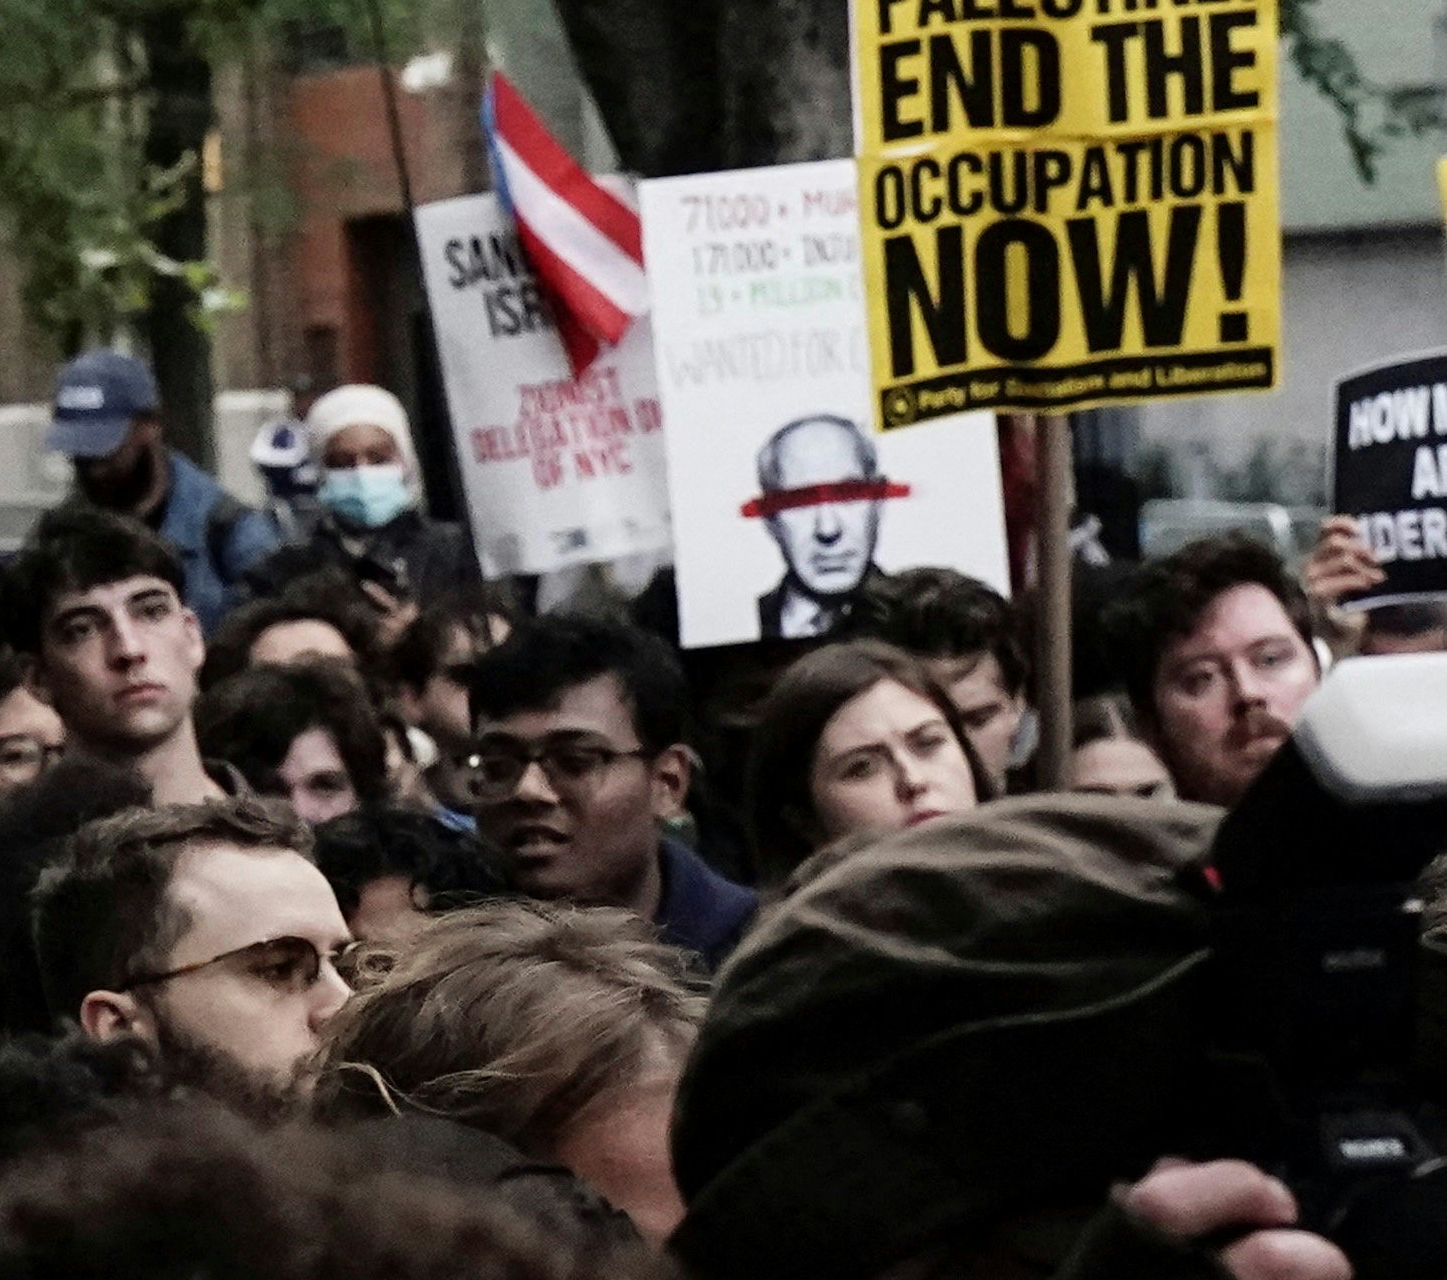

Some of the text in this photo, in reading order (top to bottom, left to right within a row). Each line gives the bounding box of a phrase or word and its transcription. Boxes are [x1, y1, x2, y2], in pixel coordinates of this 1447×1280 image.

[878, 10, 1260, 143] END THE
[875, 130, 1255, 231] OCCUPATION
[882, 202, 1251, 379] NOW!
[1348, 384, 1430, 451] HOW
